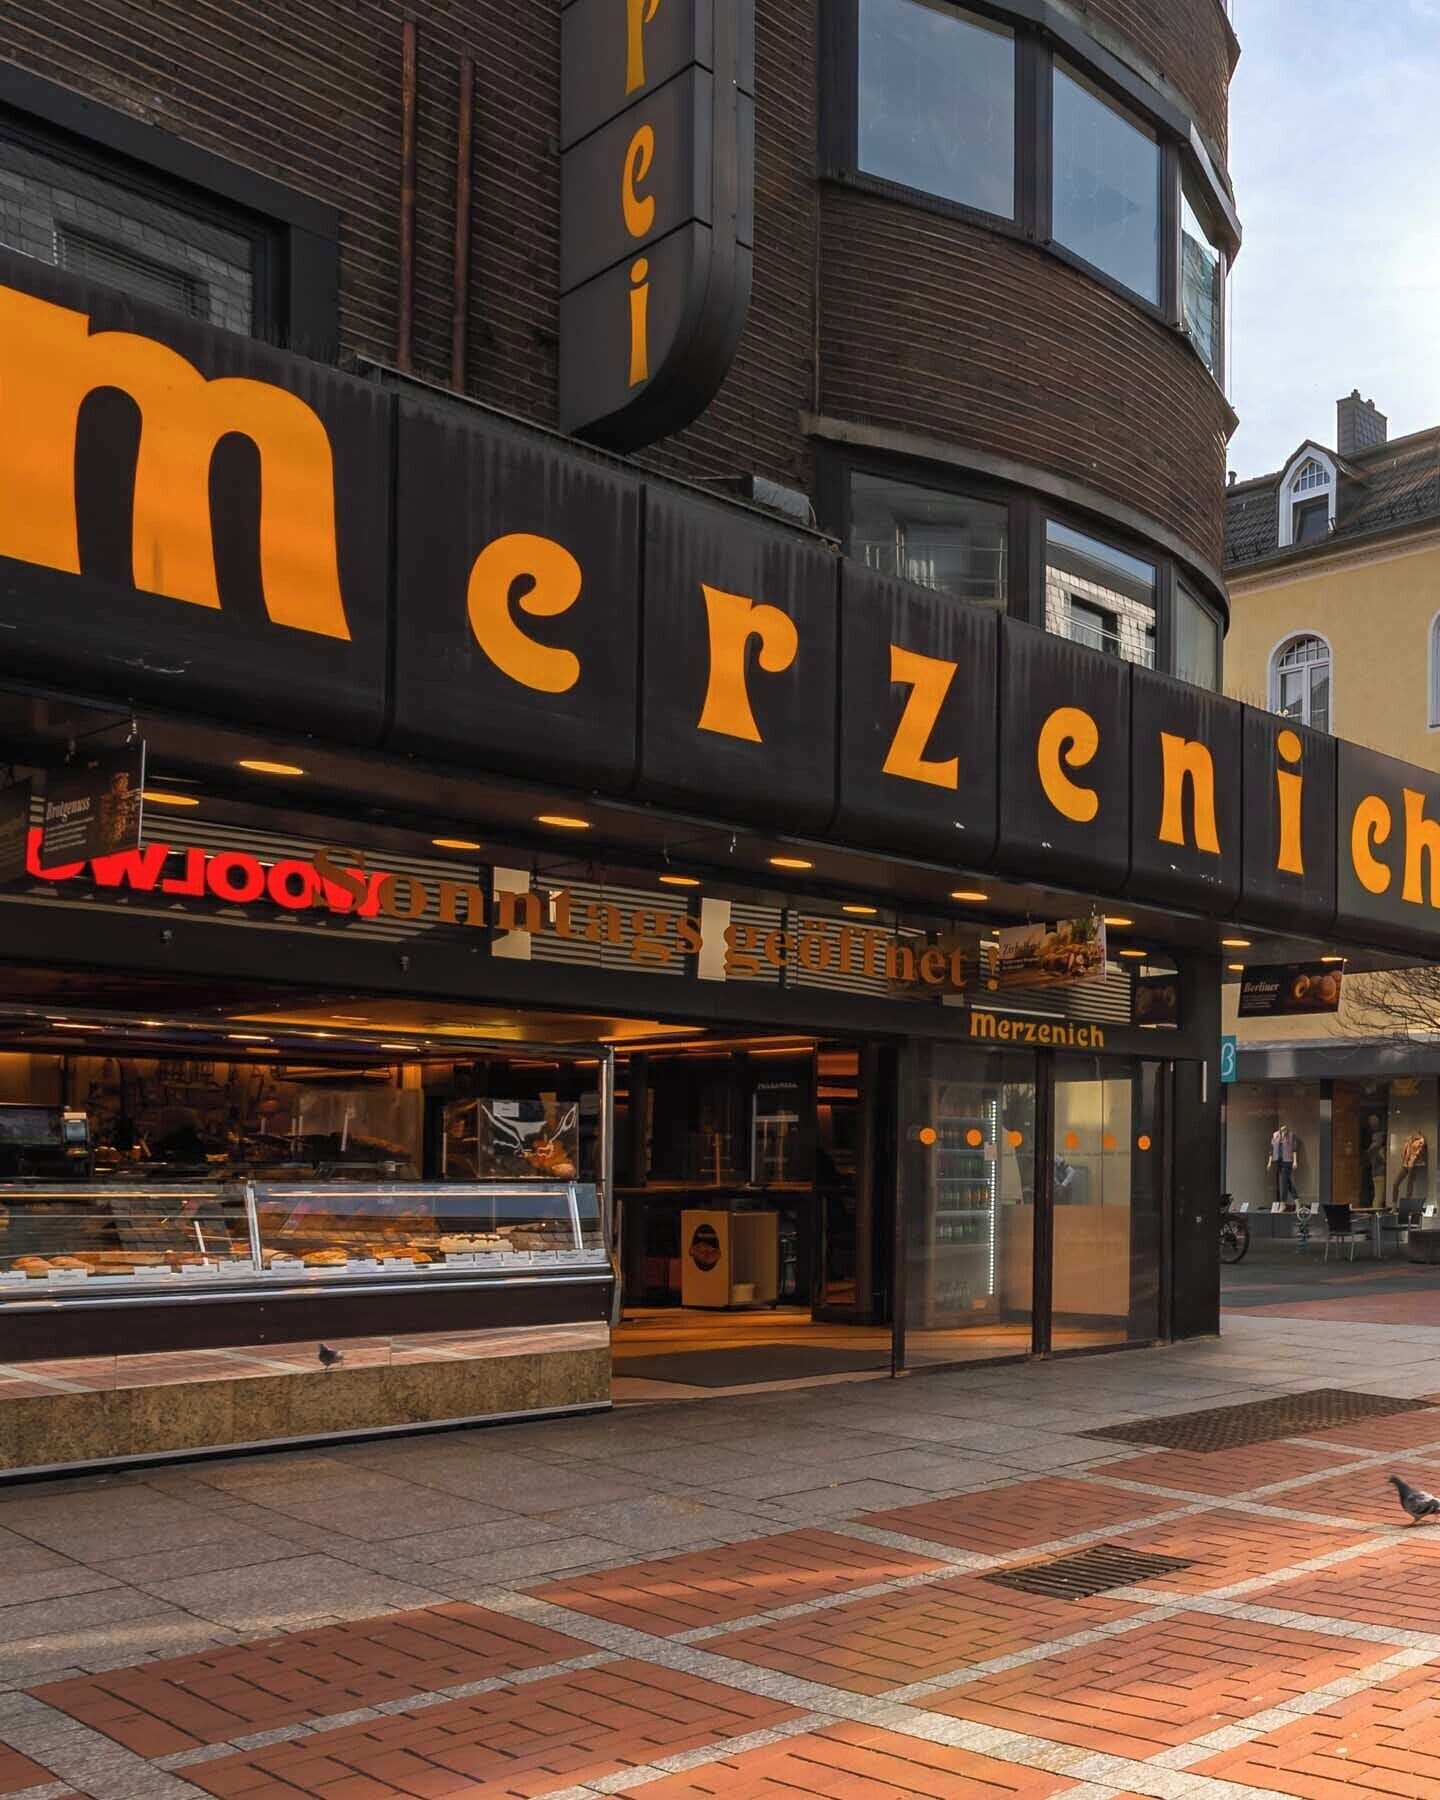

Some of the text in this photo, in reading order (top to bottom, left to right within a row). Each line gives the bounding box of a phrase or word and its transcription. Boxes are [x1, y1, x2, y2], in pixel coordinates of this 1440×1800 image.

[313, 846, 703, 966] Sonntags
[723, 919, 967, 987] geöffnet
[1243, 982, 1280, 993] Berliner
